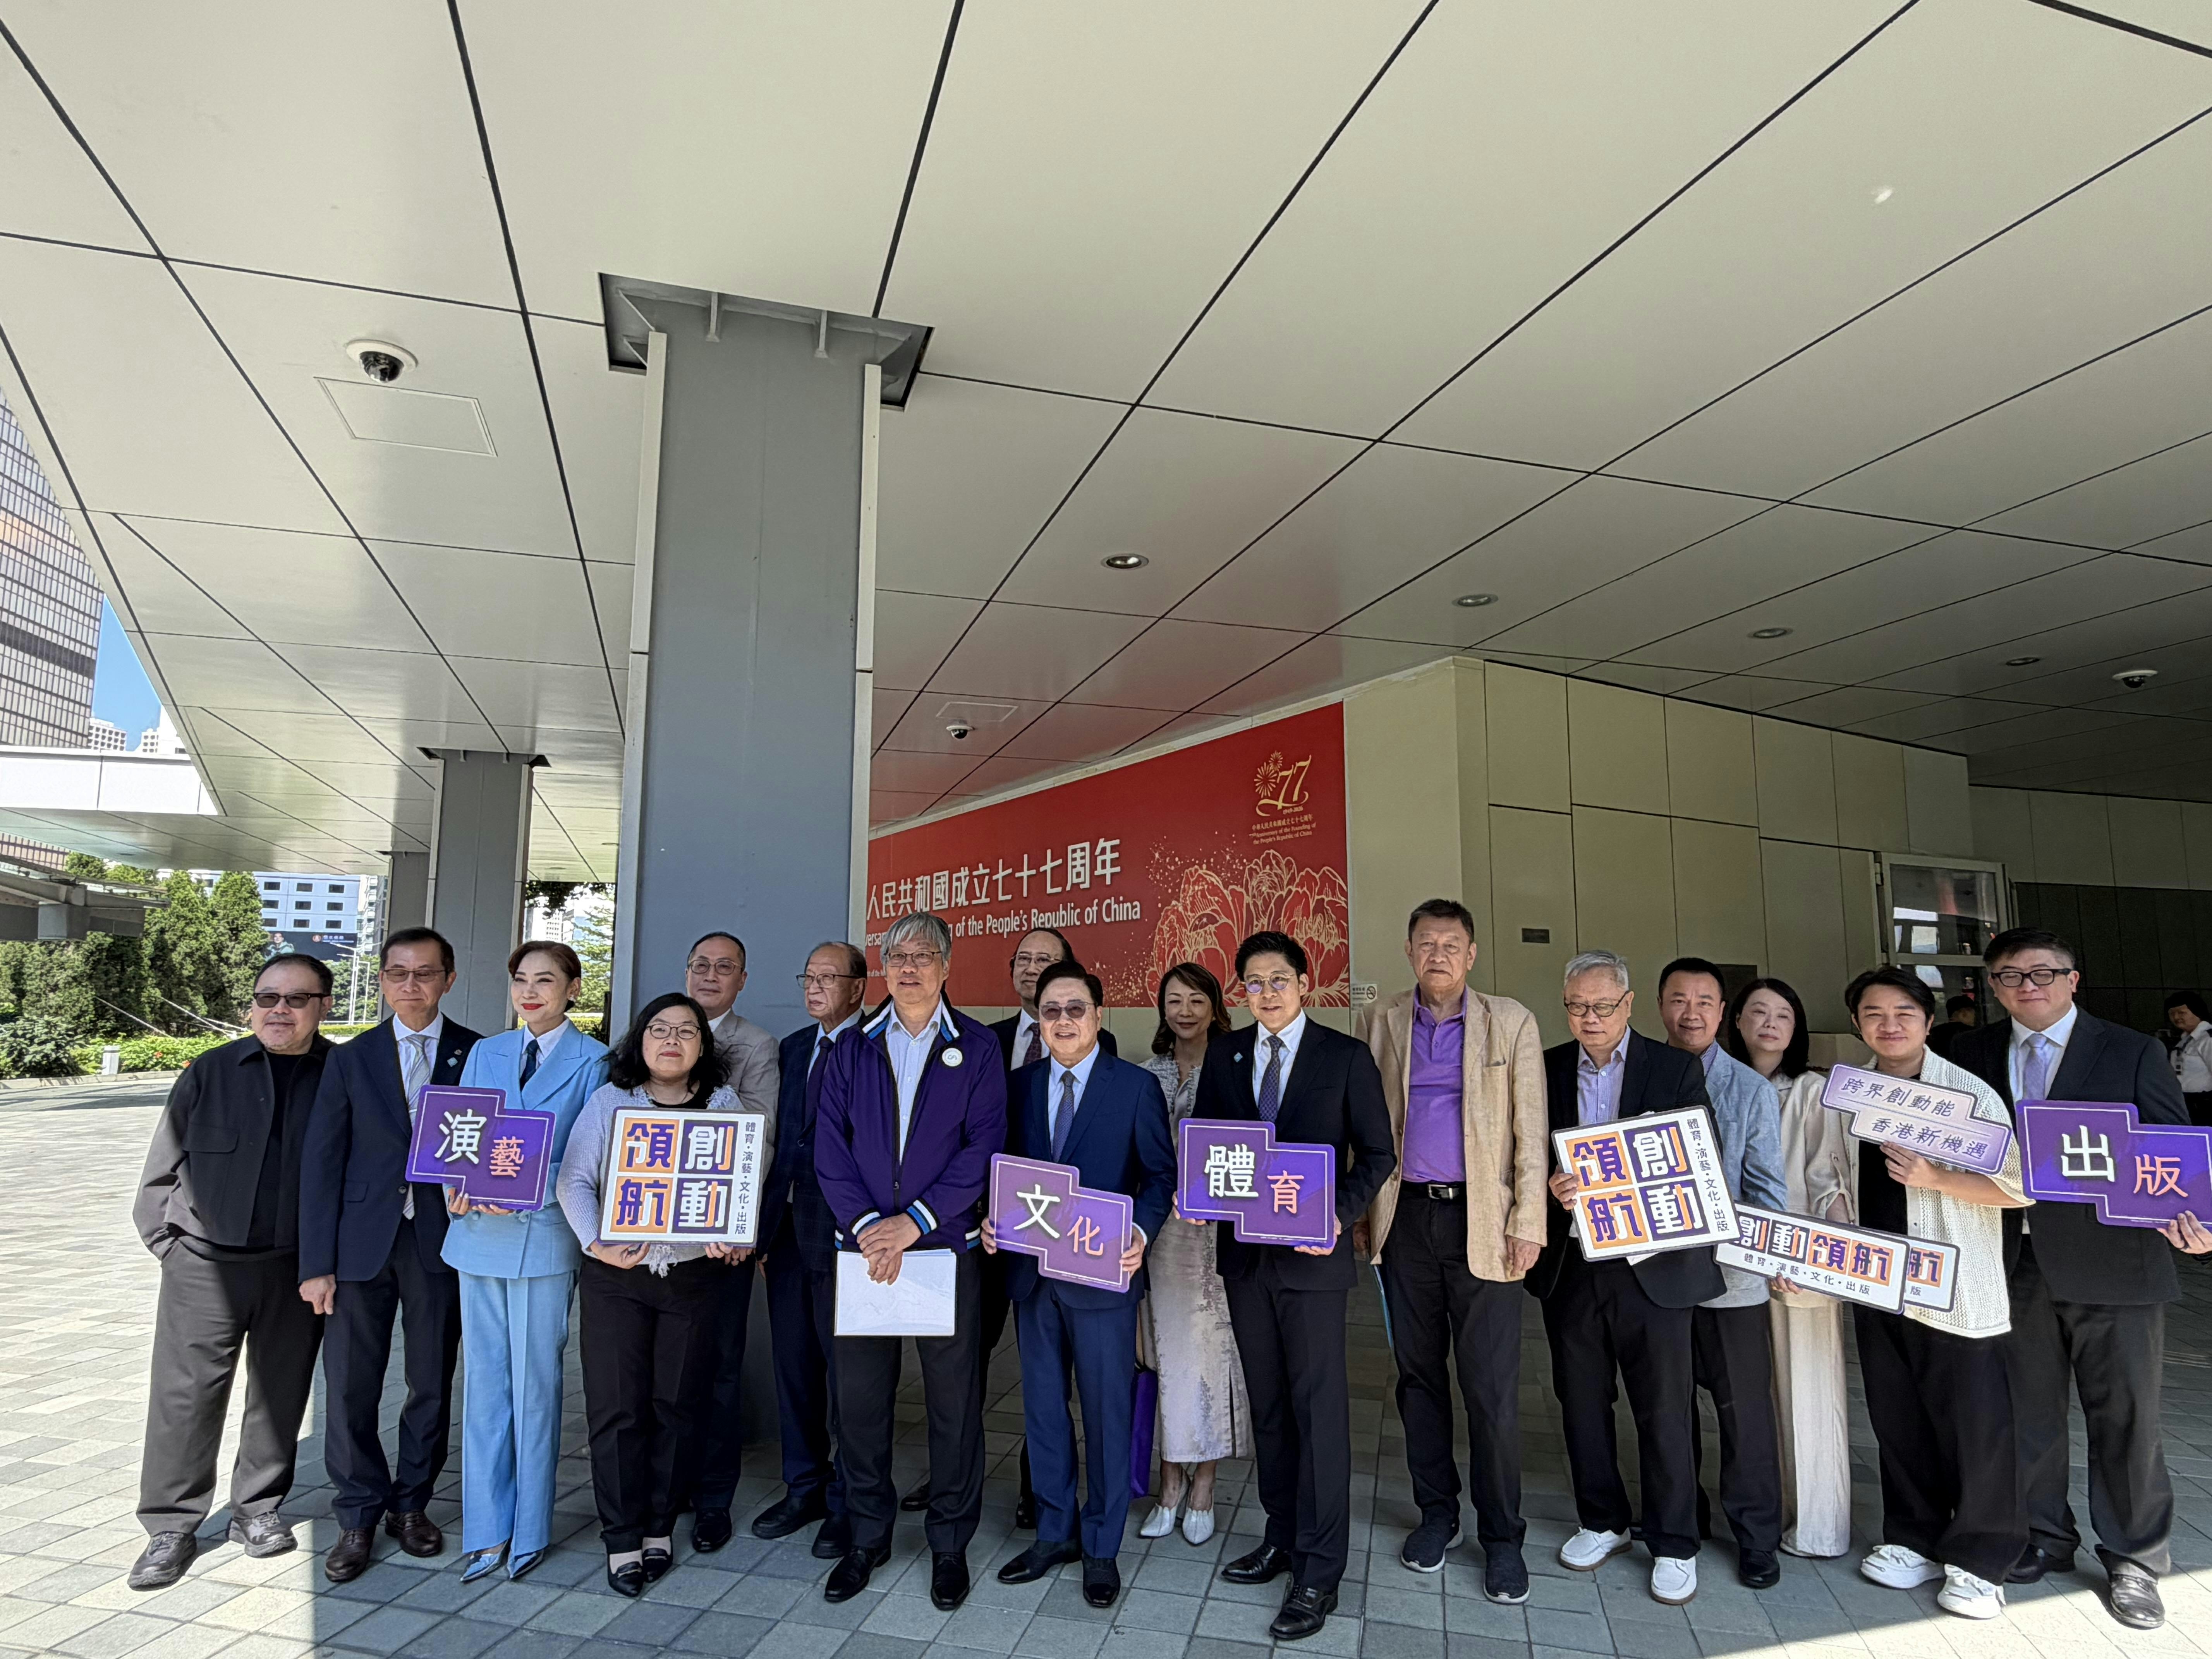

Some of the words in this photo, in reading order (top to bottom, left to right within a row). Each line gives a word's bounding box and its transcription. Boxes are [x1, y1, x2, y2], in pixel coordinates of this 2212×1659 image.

[867, 838, 1121, 921] 人民共和國成立七十七周年
[955, 916, 966, 938] of
[968, 915, 983, 936] the
[1085, 898, 1099, 925] of
[1102, 896, 1140, 923] China
[1841, 1077, 1955, 1117] 跨界創動能
[434, 1108, 525, 1178] 演藝
[1871, 1117, 1989, 1160] 香港新機遇
[2061, 1125, 2189, 1198] 出版
[1204, 1144, 1305, 1214] 體育
[1013, 1183, 1104, 1256] 文化
[1740, 1216, 1890, 1281] 創動領航
